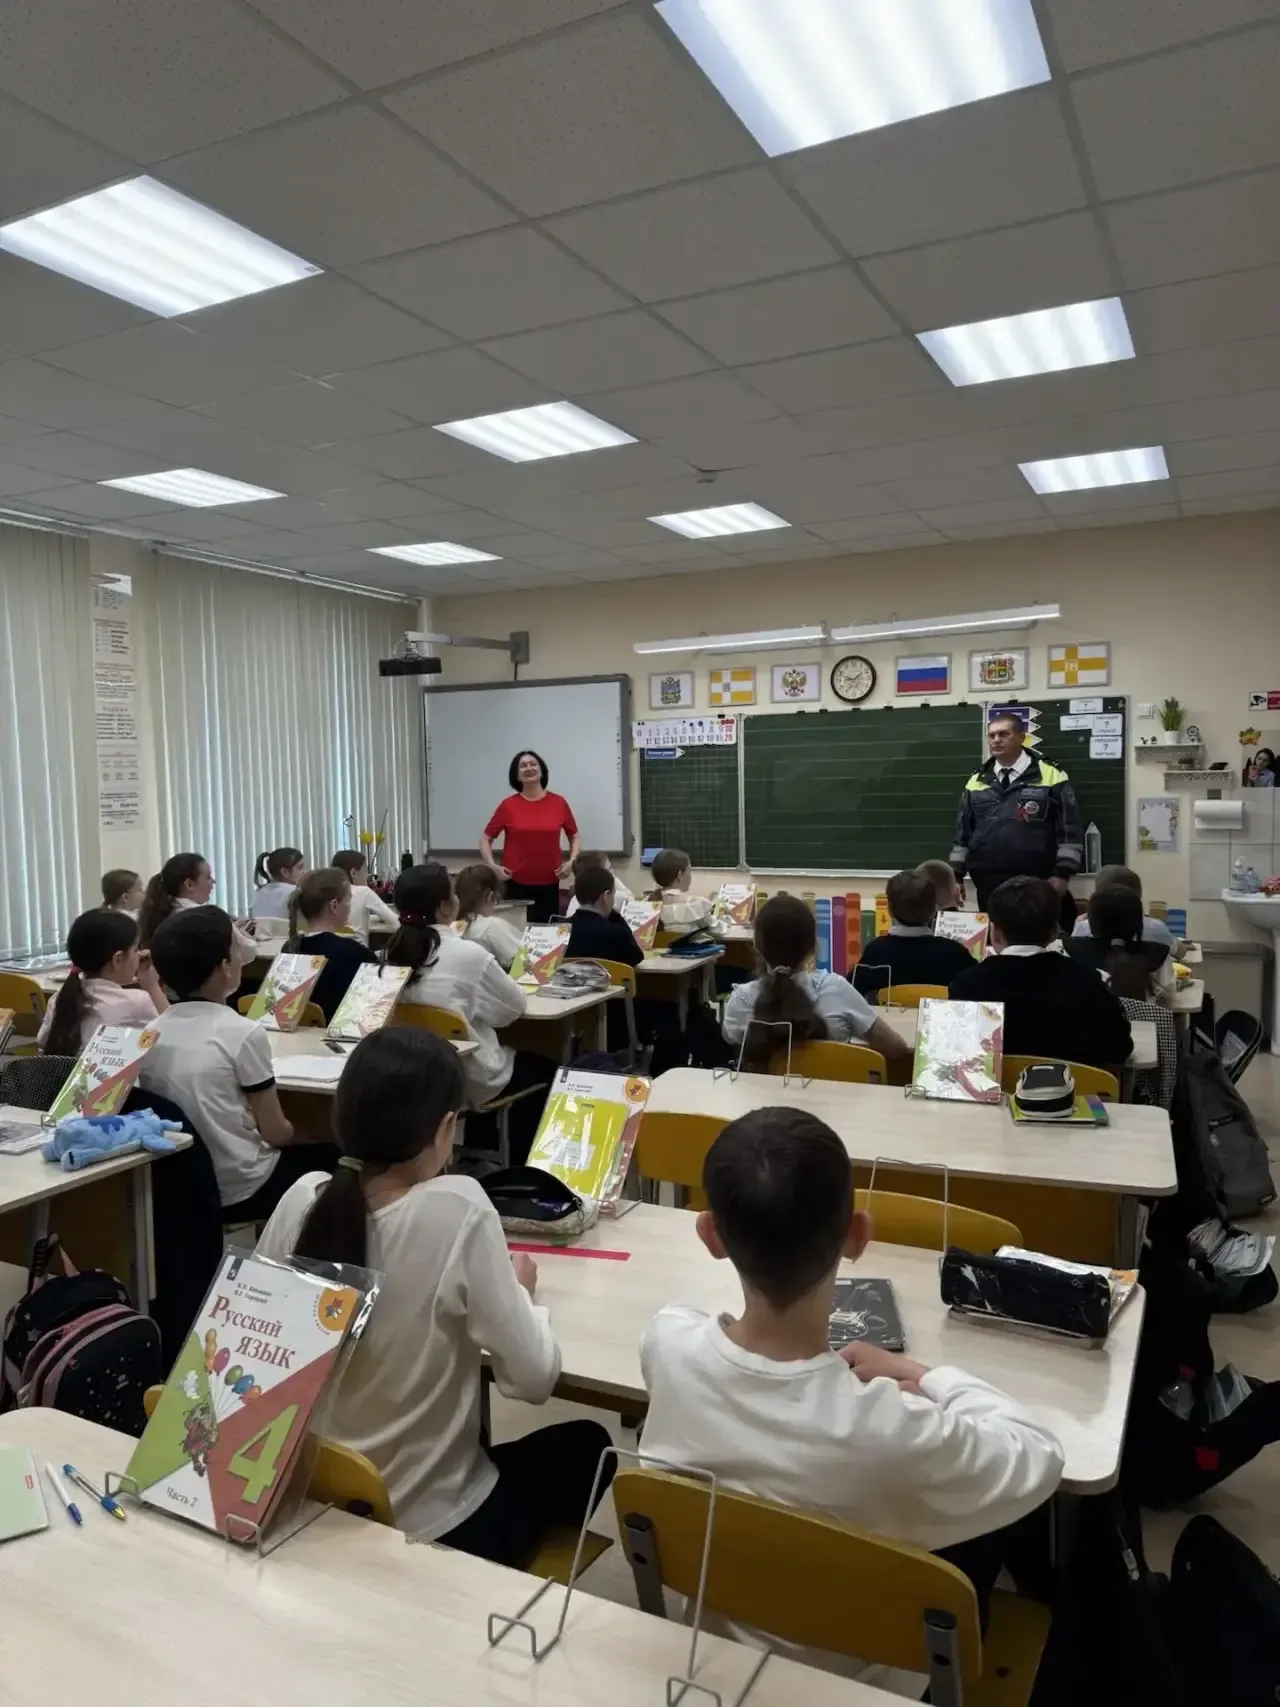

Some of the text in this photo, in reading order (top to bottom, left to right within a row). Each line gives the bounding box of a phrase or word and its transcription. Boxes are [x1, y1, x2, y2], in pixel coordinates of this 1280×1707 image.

[736, 904, 748, 920] 4
[640, 925, 653, 944] 4
[539, 956, 558, 977] 4
[281, 991, 305, 1019] 4
[92, 1080, 125, 1113] 4
[208, 1294, 284, 1338] Русский
[226, 1404, 299, 1504] 4
[166, 1485, 198, 1507] Часть 2
